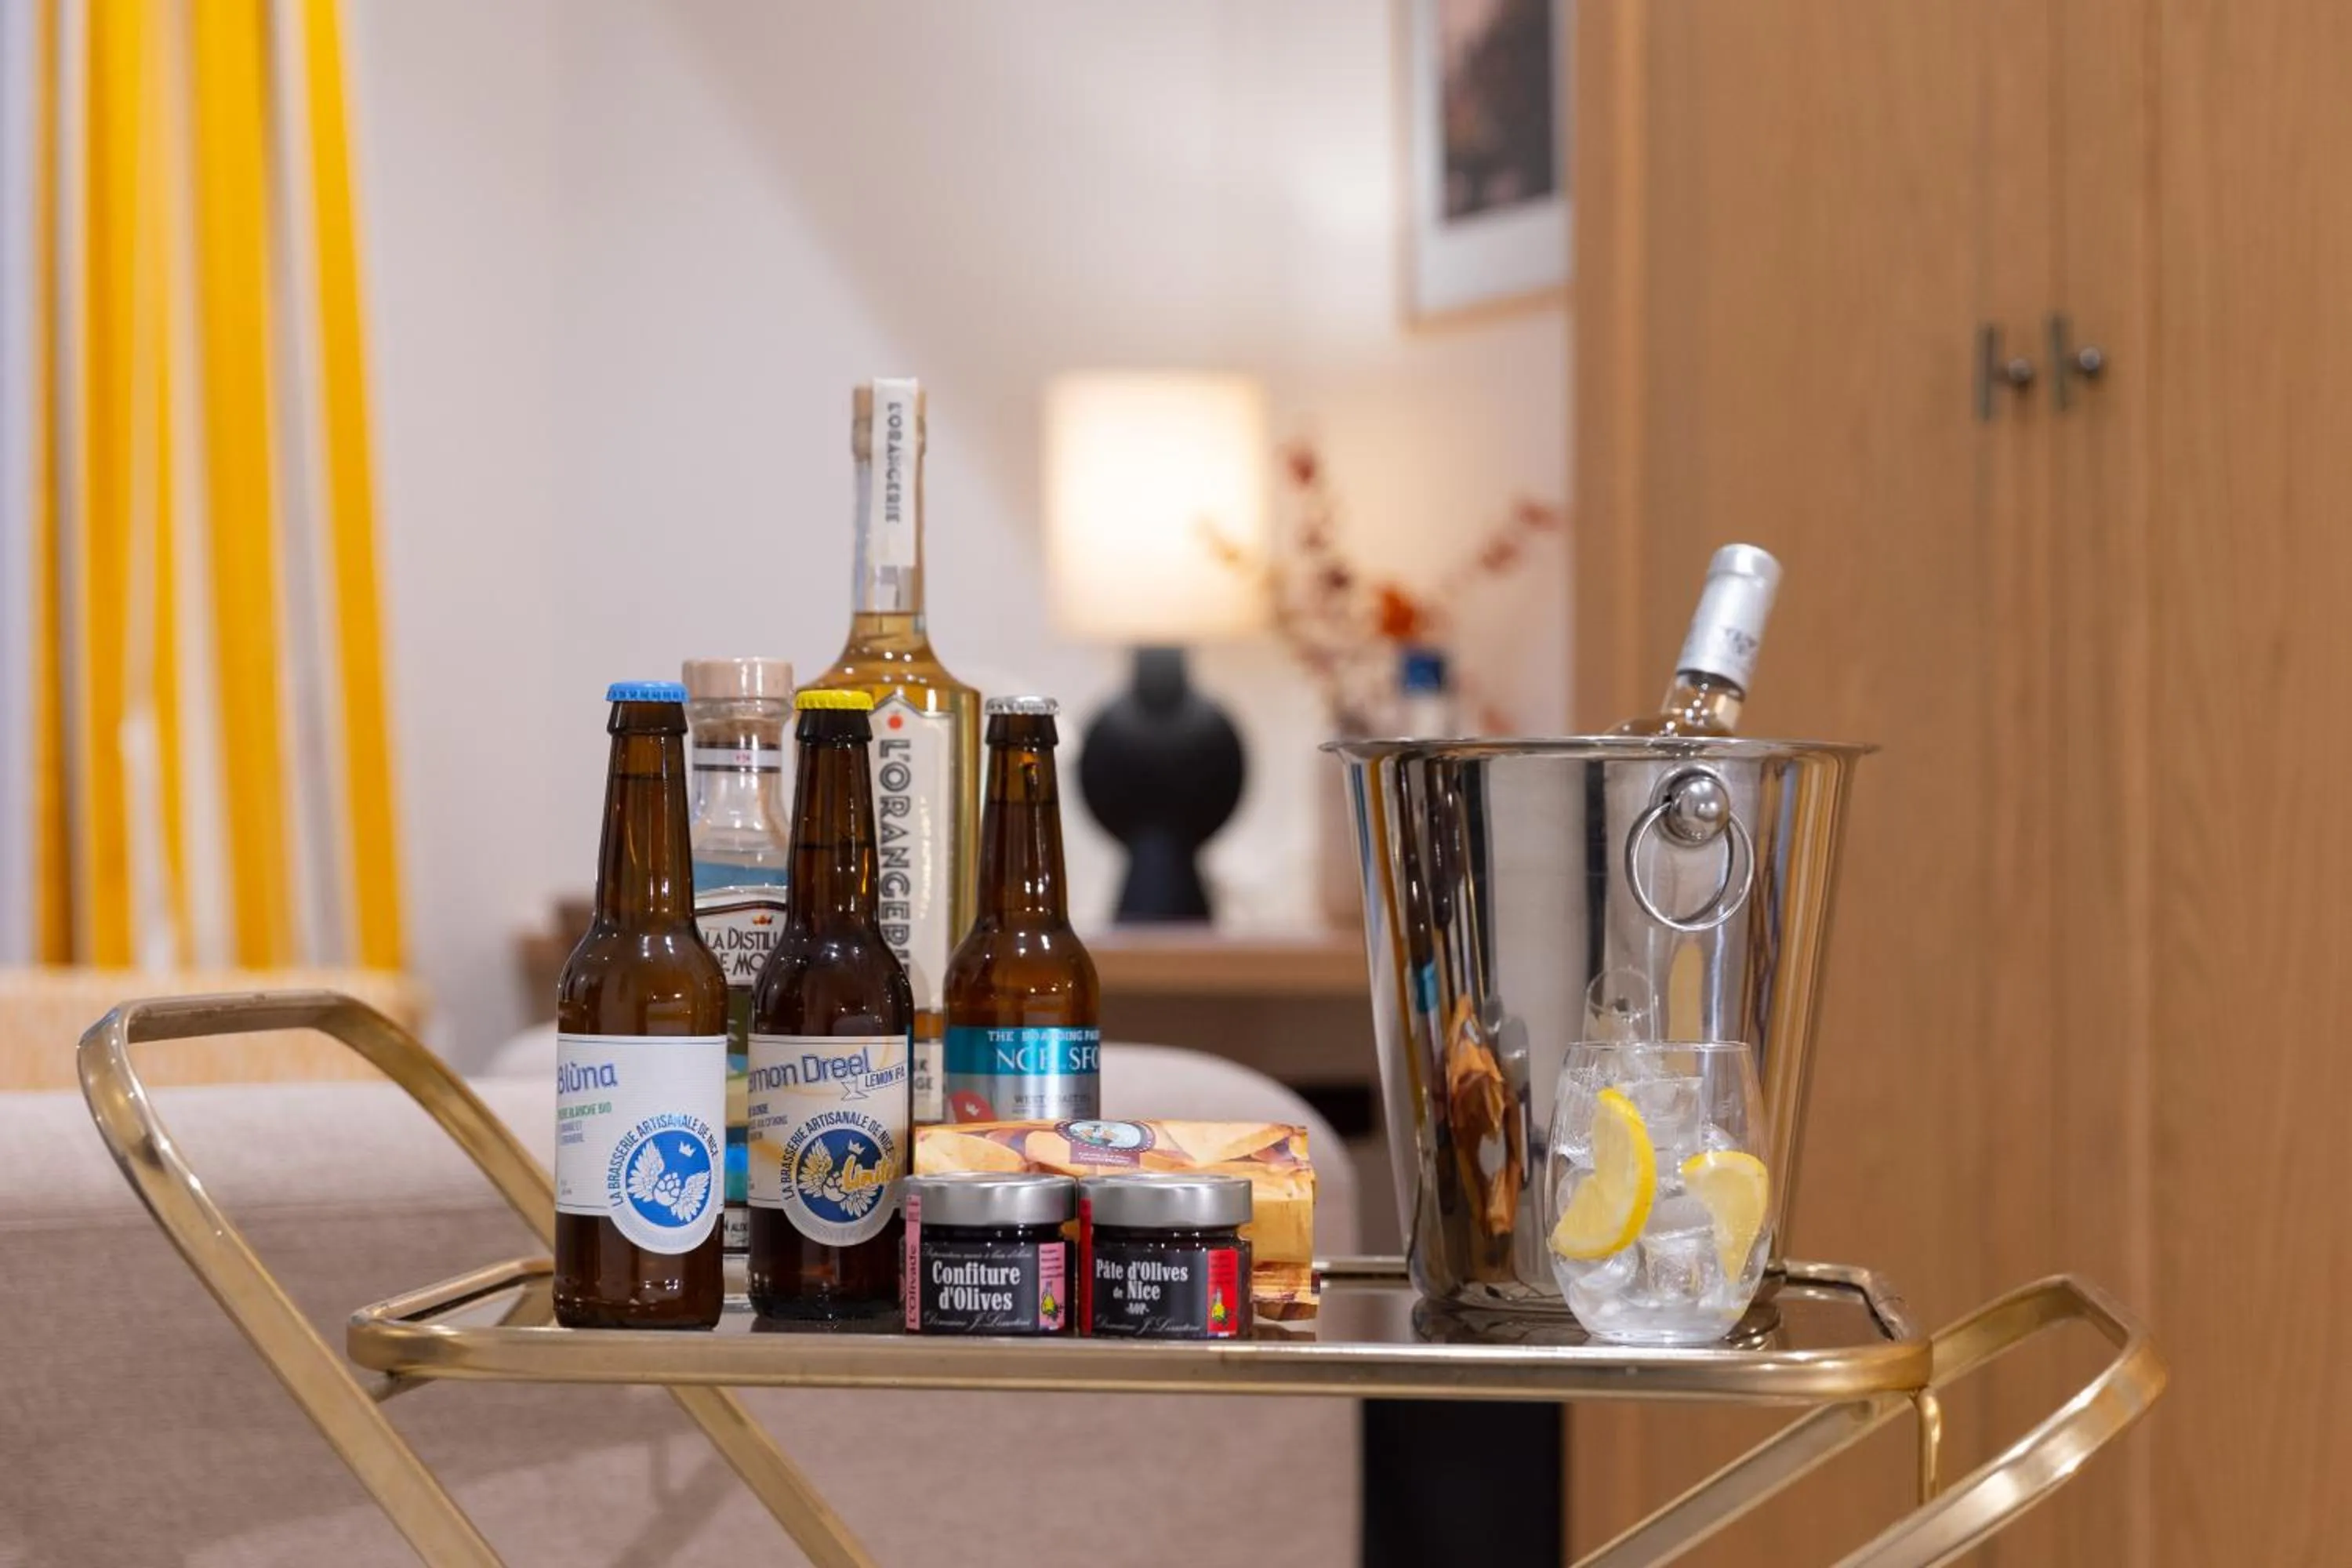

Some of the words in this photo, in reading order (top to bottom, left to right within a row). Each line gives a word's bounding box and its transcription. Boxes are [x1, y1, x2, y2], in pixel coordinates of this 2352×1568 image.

[879, 739, 911, 978] L'ORANGER
[987, 1029, 1014, 1043] THE
[802, 1046, 871, 1083] Dreel
[805, 1110, 869, 1134] ARTISANALE
[868, 1120, 881, 1138] DE
[608, 1131, 639, 1189] BRASSERIE
[780, 1127, 808, 1183] BRASSERIE
[609, 1192, 623, 1207] LA
[782, 1185, 795, 1200] LA
[932, 1259, 1021, 1285] Confiture
[1127, 1261, 1189, 1282] d'Olives
[938, 1286, 1014, 1311] d'Olives
[1127, 1280, 1161, 1301] Nice
